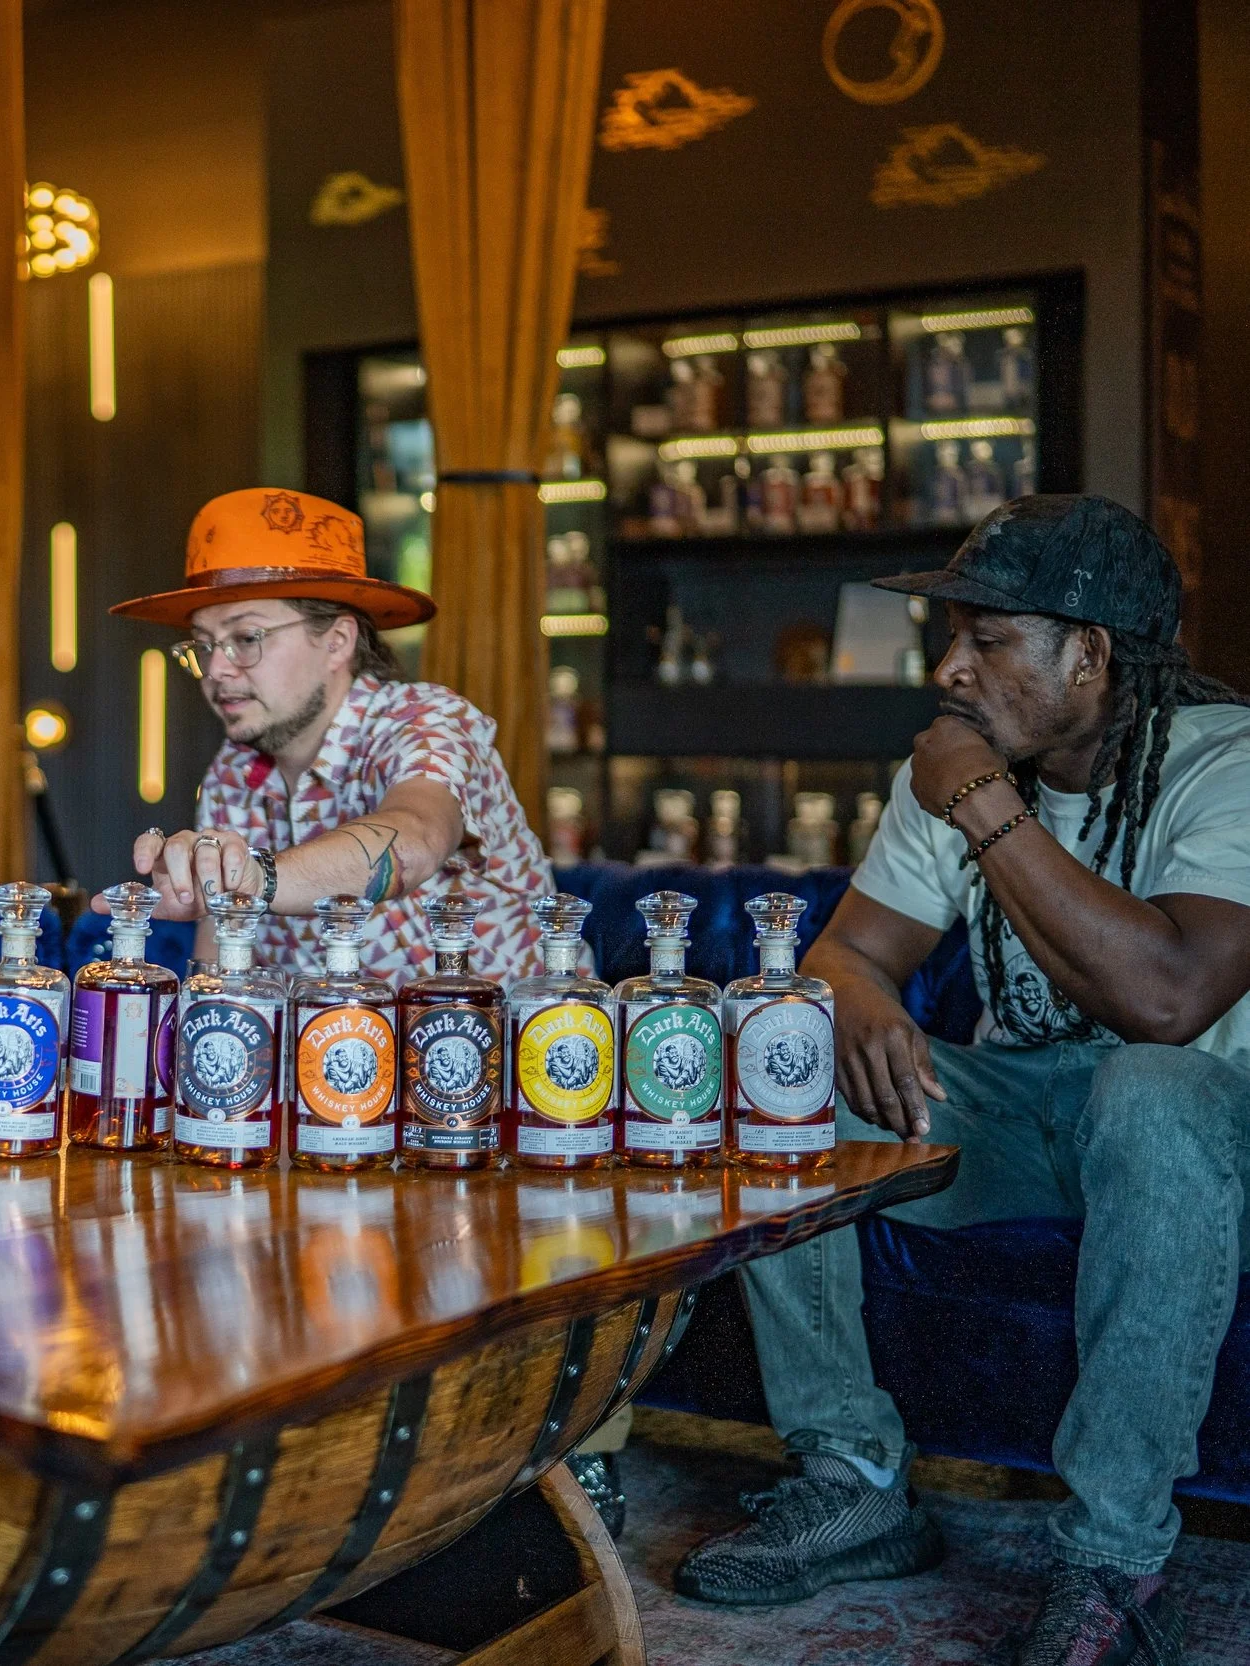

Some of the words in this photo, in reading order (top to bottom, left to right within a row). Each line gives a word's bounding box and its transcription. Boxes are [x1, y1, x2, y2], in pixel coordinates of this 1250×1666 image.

[11, 1002, 48, 1038] Arts
[183, 1008, 222, 1042] Dark
[223, 1010, 261, 1045] Arts
[306, 1015, 353, 1050] Dark
[355, 1016, 388, 1048] Arts
[410, 1013, 456, 1049] Dark
[456, 1014, 493, 1048] Arts
[528, 1011, 575, 1046] Dark
[580, 1012, 608, 1044] Arts
[635, 1011, 685, 1046] Dark
[686, 1012, 715, 1045] Arts
[745, 1008, 794, 1040] Dark
[797, 1009, 827, 1040] Arts
[13, 1073, 44, 1097] HOUSE
[184, 1076, 221, 1105] WHISKEY
[225, 1081, 258, 1105] HOUSE
[312, 1085, 355, 1112] WHISKEY
[360, 1084, 387, 1110] HOUSE
[414, 1083, 457, 1111] WHISKEY
[462, 1083, 491, 1110] HOUSE
[534, 1081, 578, 1109] WHISKEY
[582, 1081, 608, 1108] HOUSE
[641, 1081, 685, 1109] WHISKEY
[690, 1081, 715, 1108] HOUSE
[753, 1079, 798, 1105] WHISKEY
[803, 1076, 828, 1104] HOUSE
